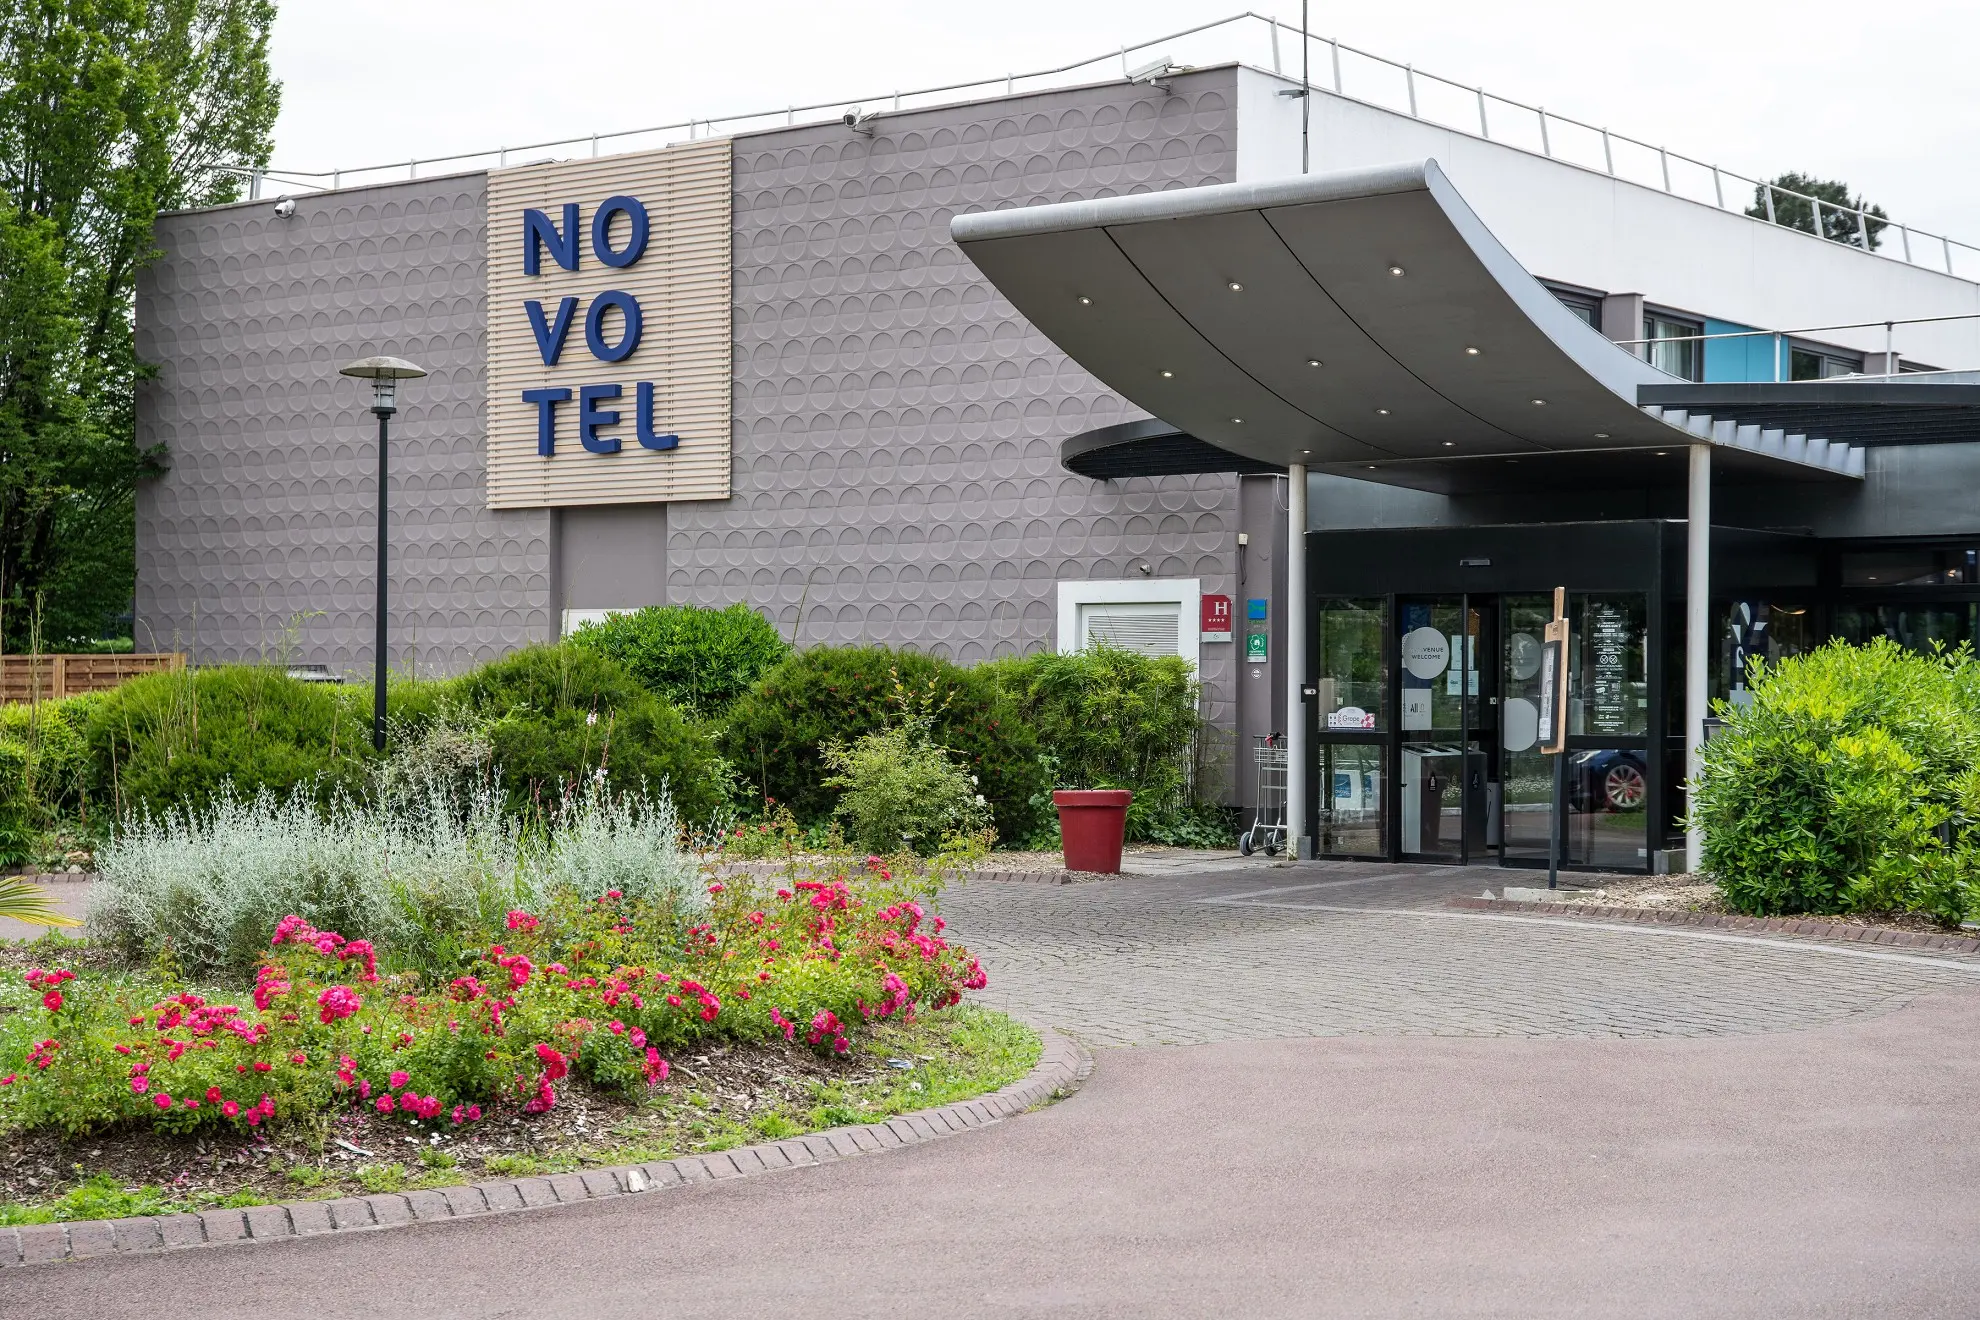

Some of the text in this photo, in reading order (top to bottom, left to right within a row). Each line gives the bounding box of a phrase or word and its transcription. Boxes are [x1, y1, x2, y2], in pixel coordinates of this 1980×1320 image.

[523, 195, 649, 276] NO
[523, 290, 643, 366] VO
[522, 382, 679, 456] TEL
[1214, 601, 1228, 616] H
